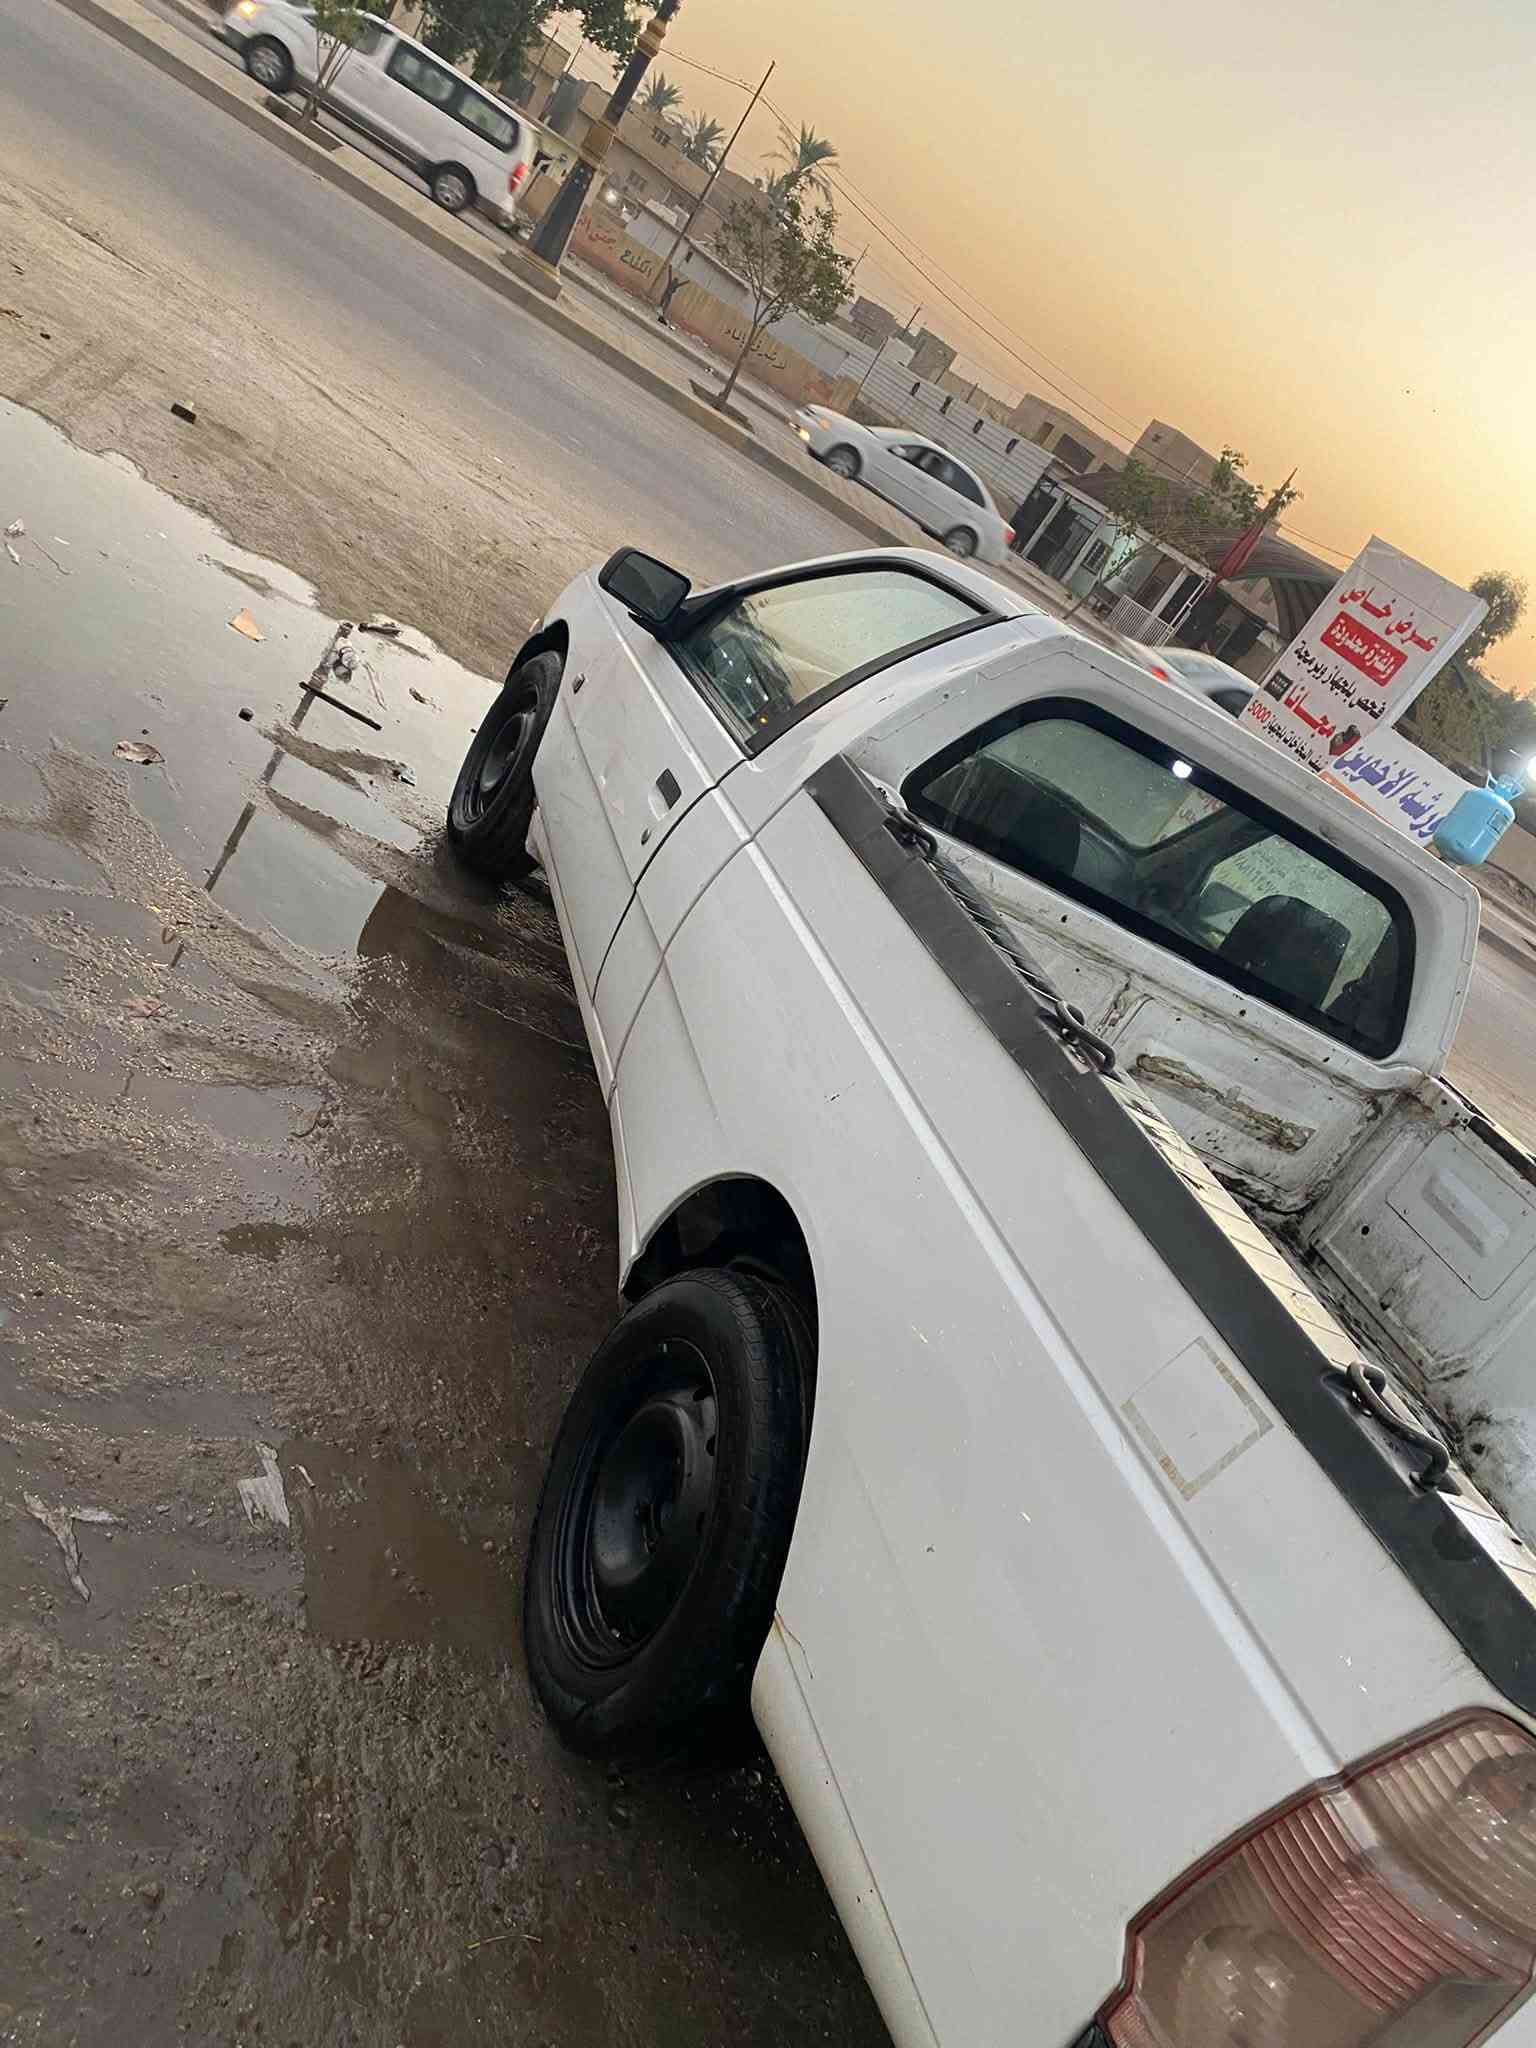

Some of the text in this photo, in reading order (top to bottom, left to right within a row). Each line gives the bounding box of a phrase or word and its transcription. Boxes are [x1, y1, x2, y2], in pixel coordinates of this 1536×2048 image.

[1330, 618, 1396, 679] ولفترة محدودة
[1338, 587, 1438, 652] عرض خاص
[1247, 699, 1272, 724] 5000
[1348, 698, 1386, 719] فحص
[1399, 780, 1447, 838] ورشة
